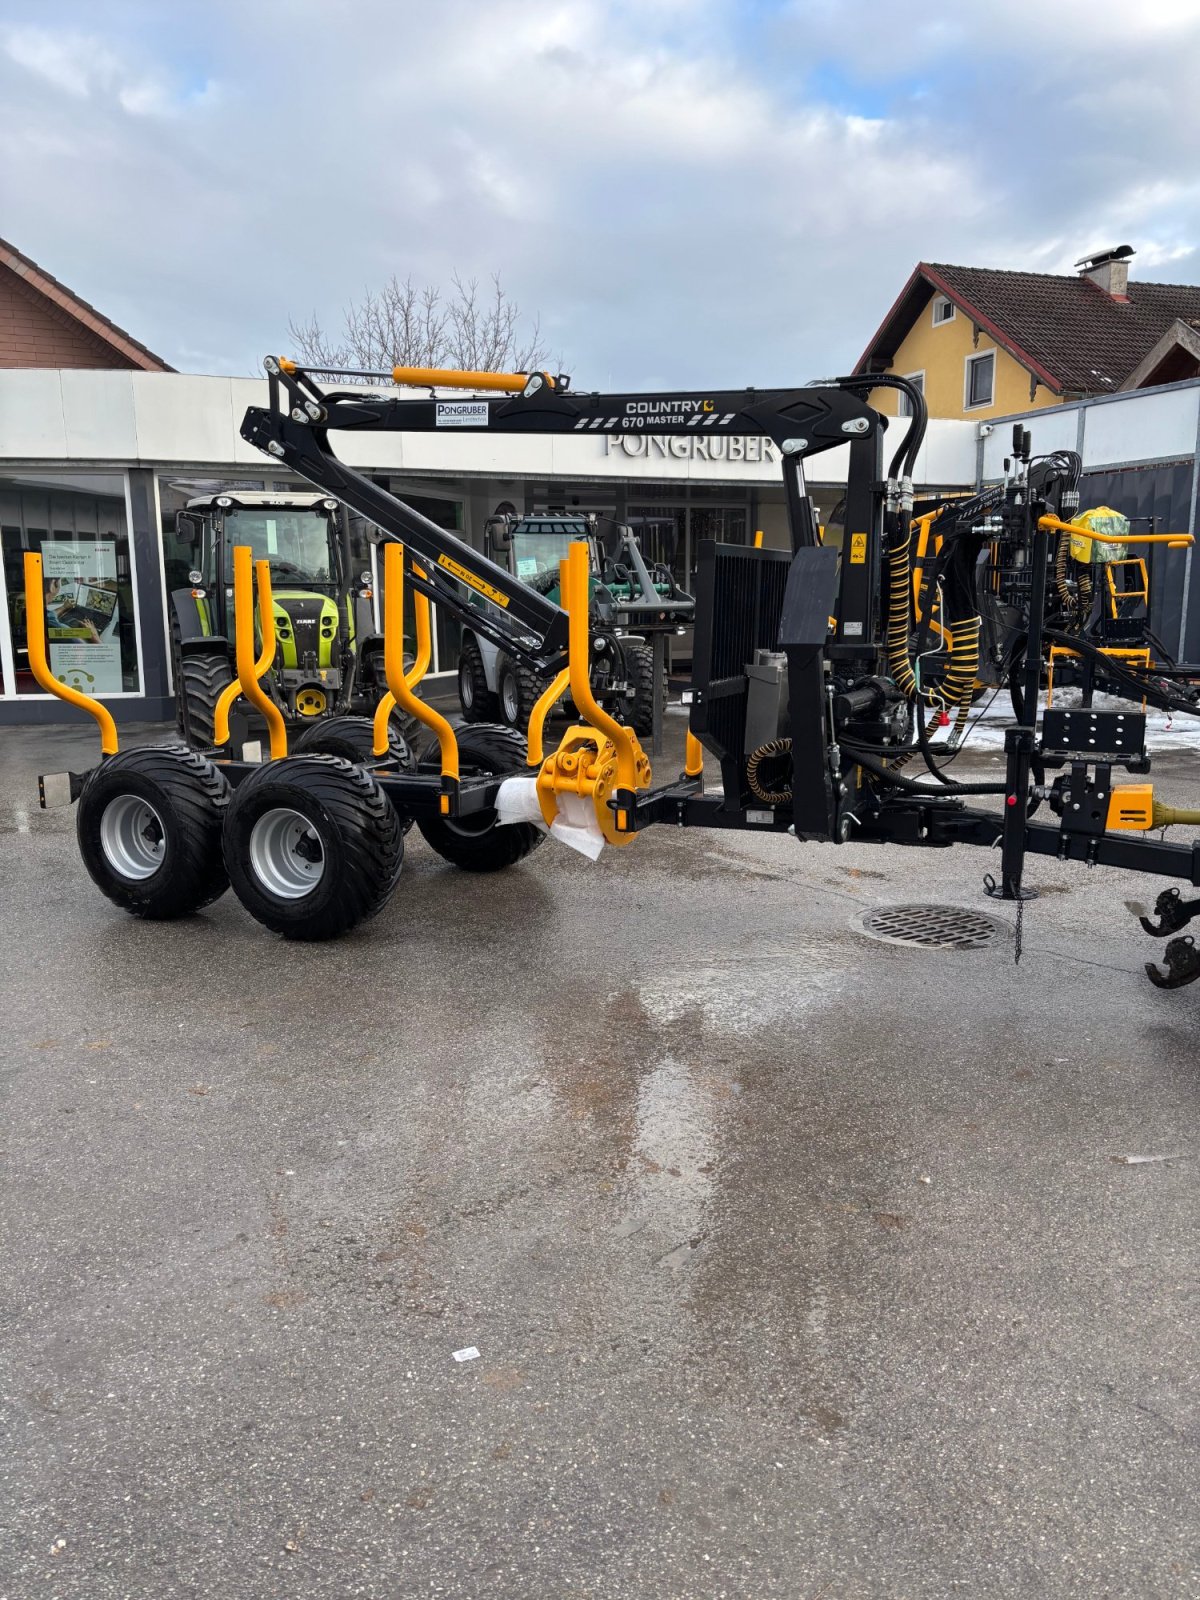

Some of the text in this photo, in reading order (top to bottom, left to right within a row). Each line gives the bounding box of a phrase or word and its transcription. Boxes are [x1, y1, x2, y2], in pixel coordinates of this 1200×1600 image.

[438, 405, 486, 416] PONGRUBER
[626, 401, 702, 414] COUNTRY
[622, 415, 685, 428] 670 MASTER
[606, 435, 774, 462] PONGRUBER
